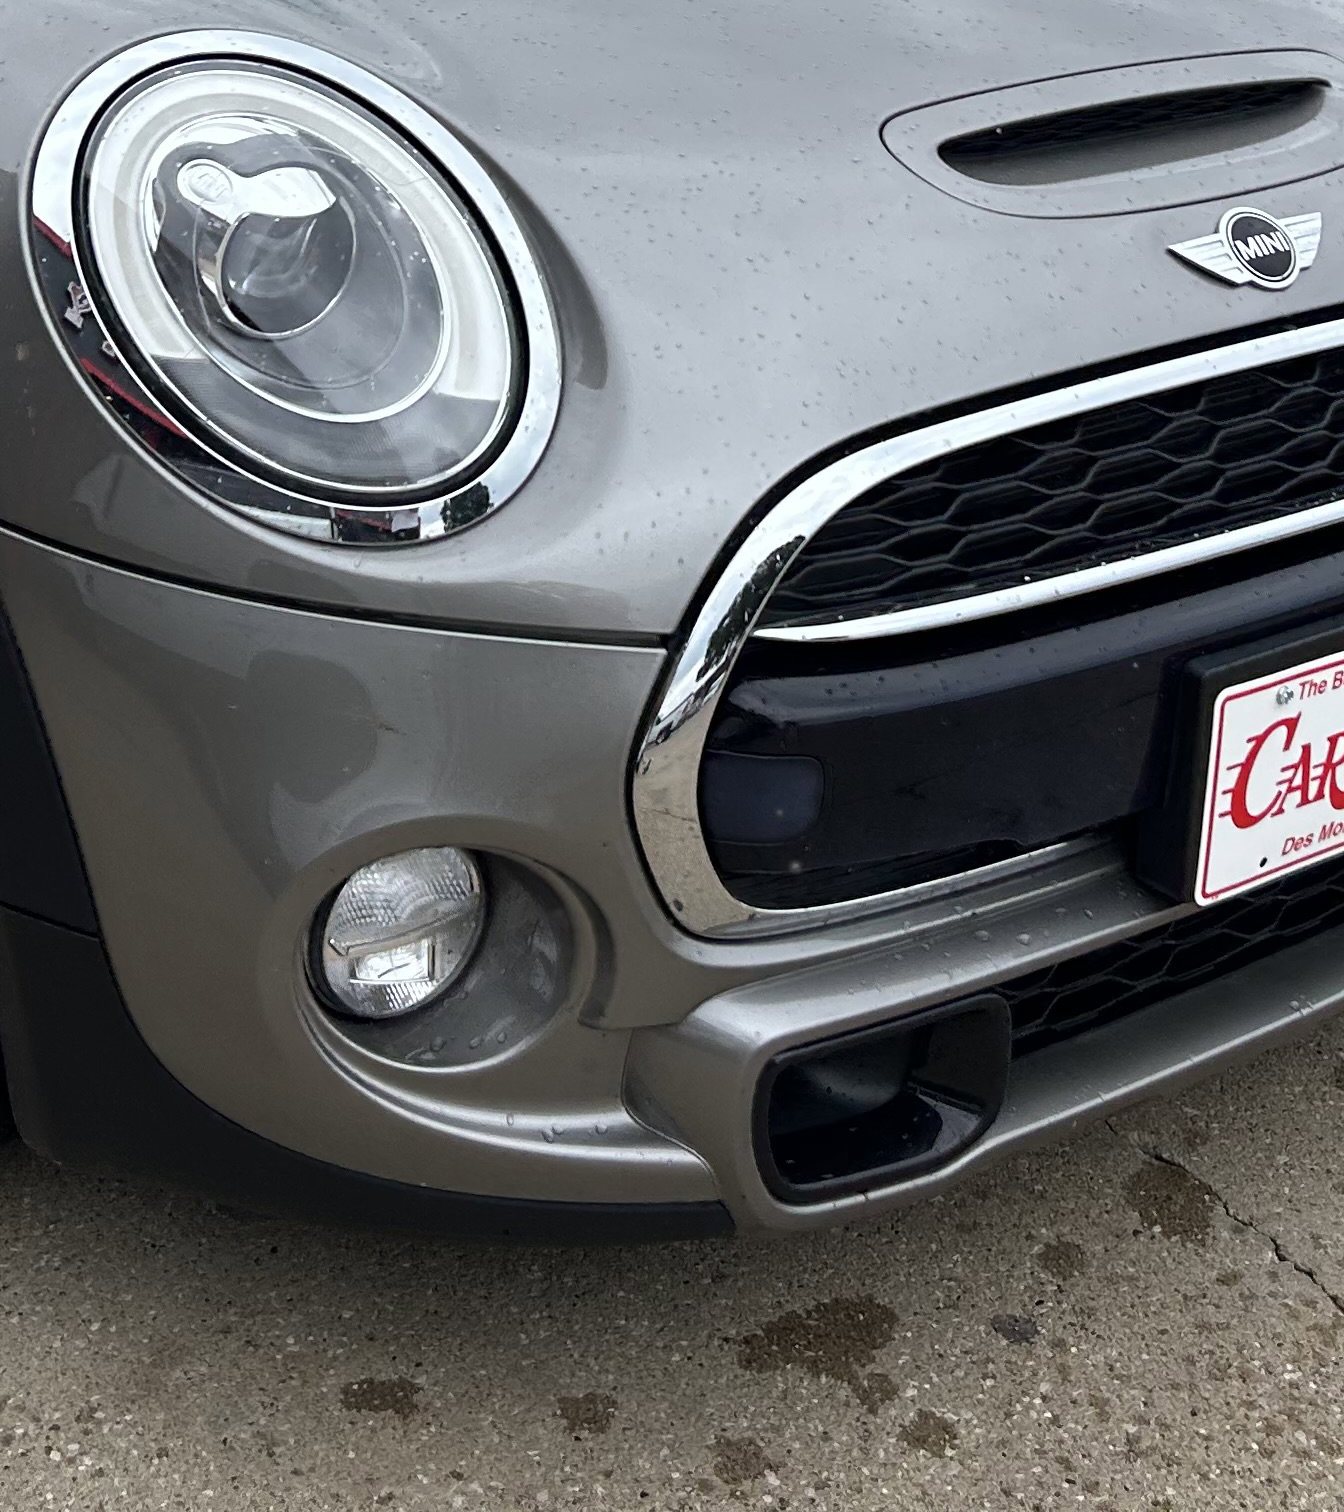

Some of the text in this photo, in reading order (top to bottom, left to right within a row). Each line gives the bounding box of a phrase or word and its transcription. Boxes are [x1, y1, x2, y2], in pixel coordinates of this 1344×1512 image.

[1233, 230, 1291, 261] MINI
[1299, 680, 1328, 700] The
[1281, 833, 1314, 857] Des
